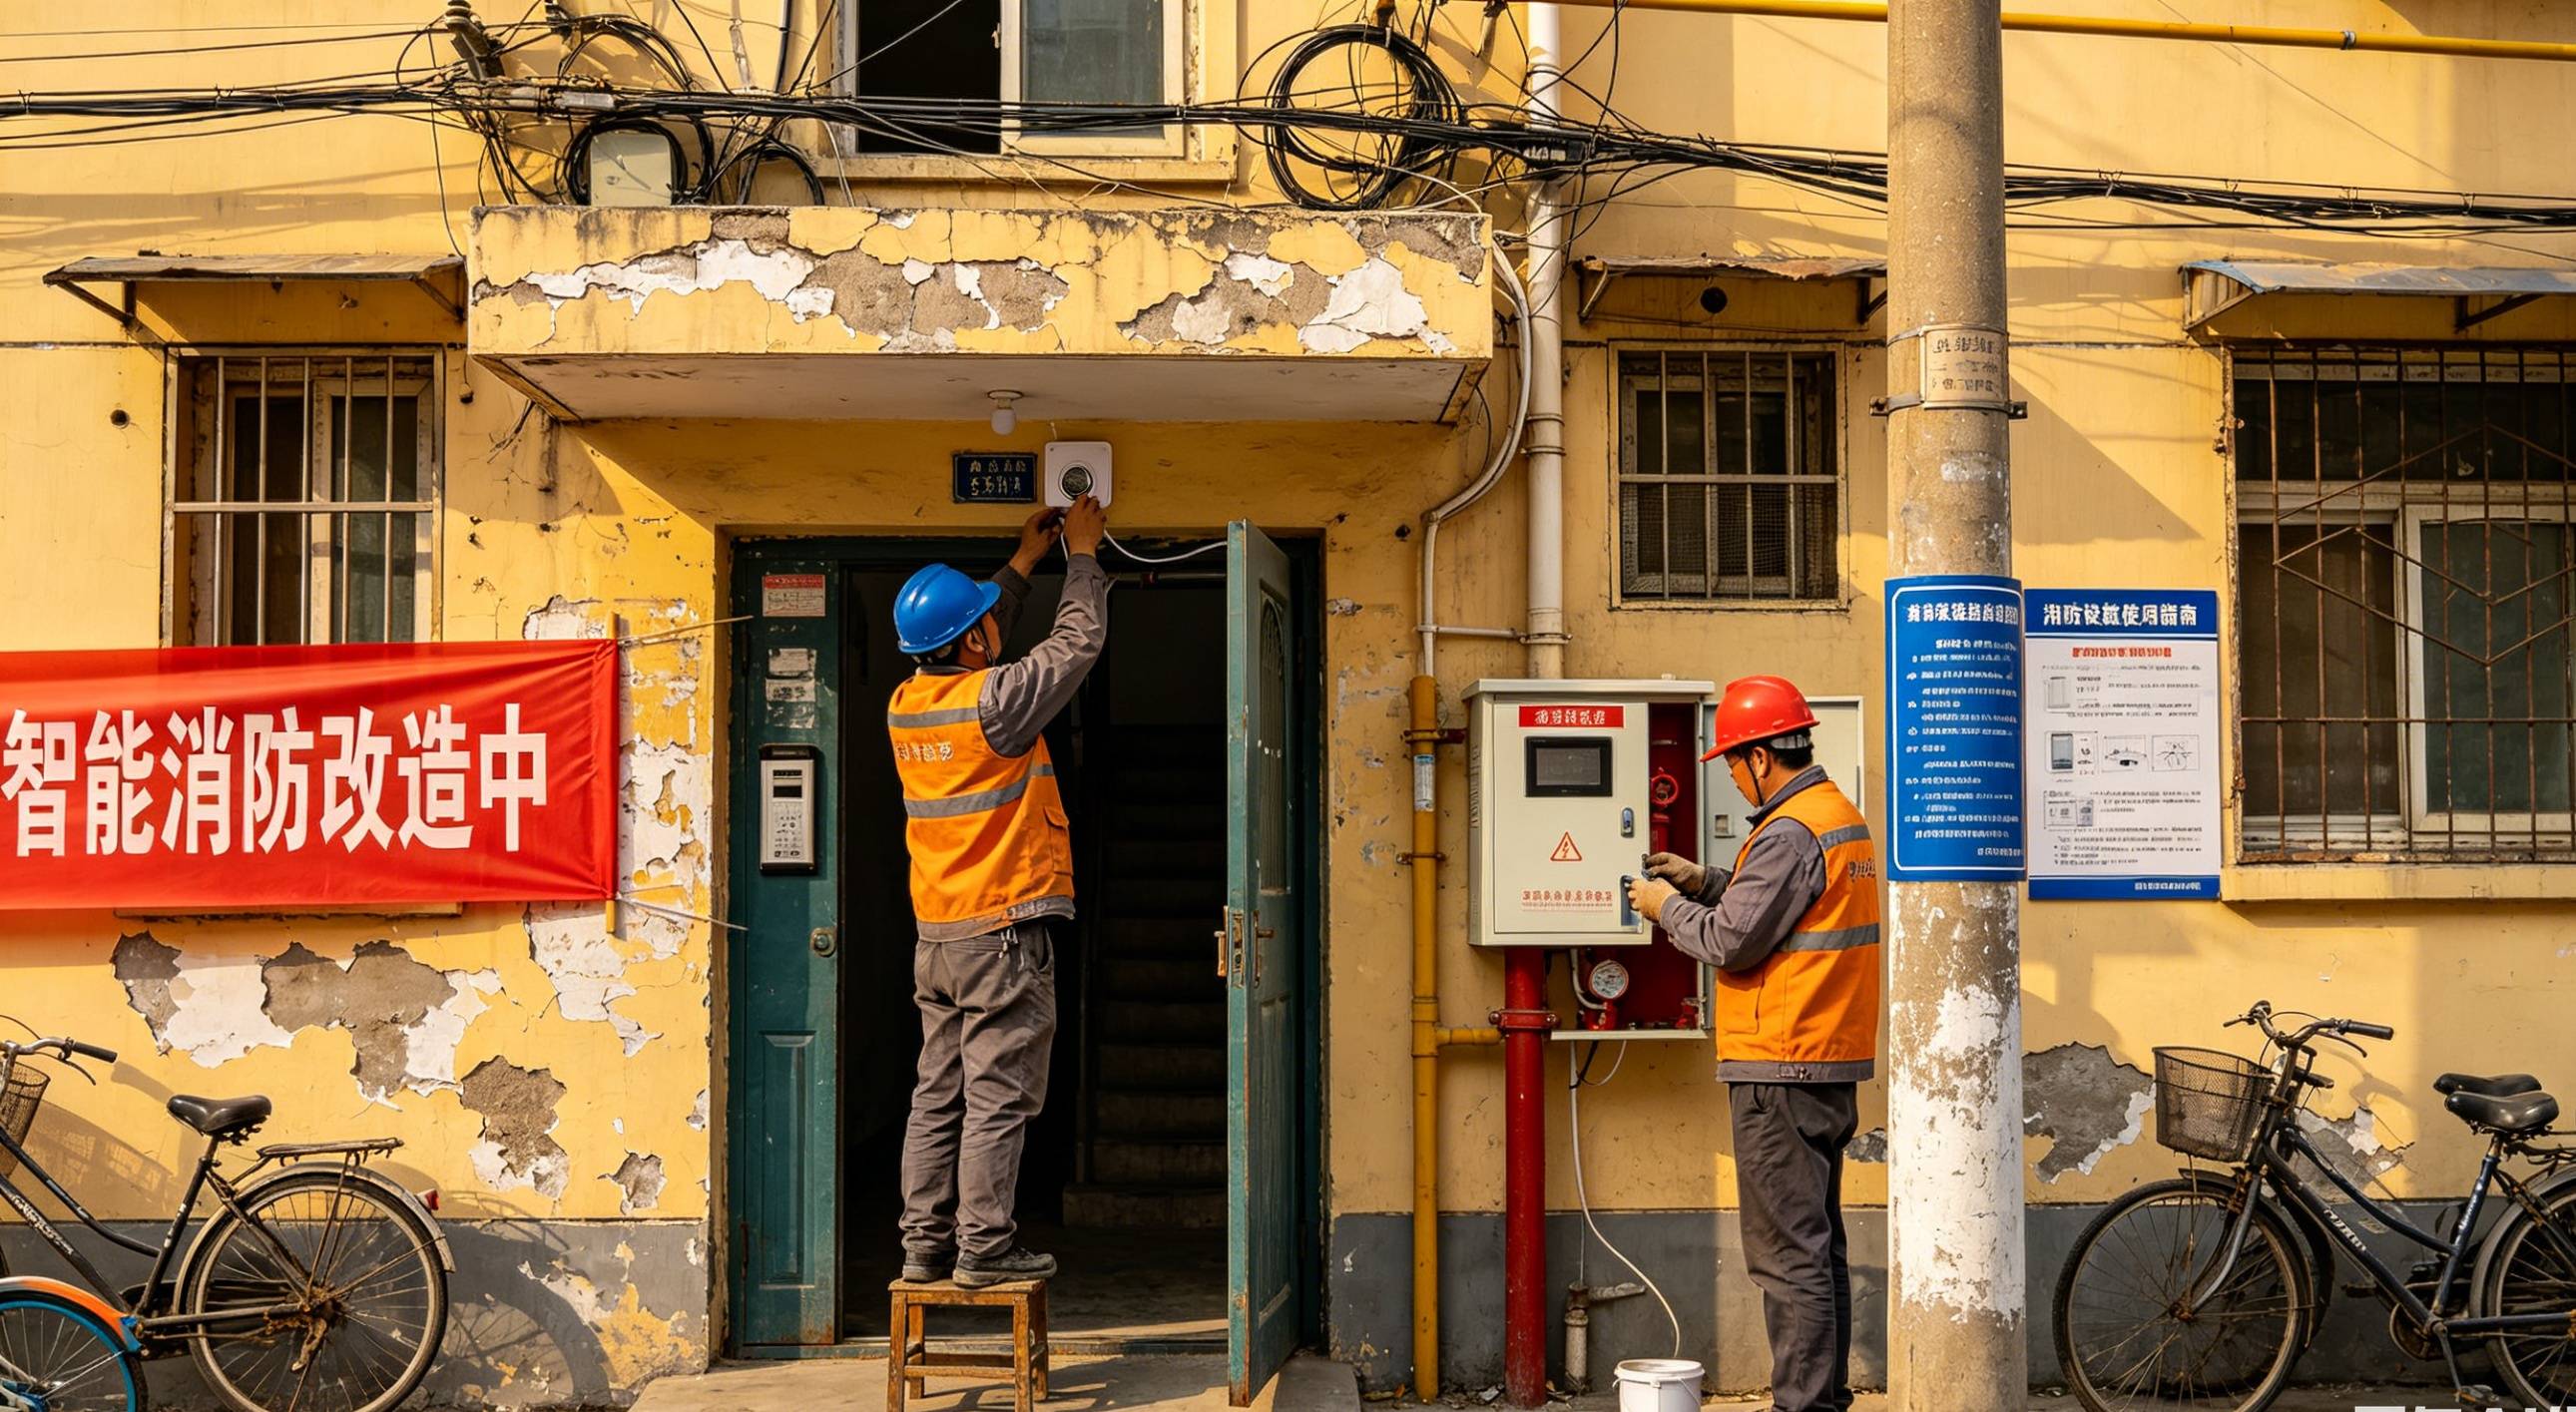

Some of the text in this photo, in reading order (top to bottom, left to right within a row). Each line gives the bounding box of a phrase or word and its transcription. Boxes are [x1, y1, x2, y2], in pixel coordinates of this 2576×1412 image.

[0, 703, 547, 857] 智能消防改造中
